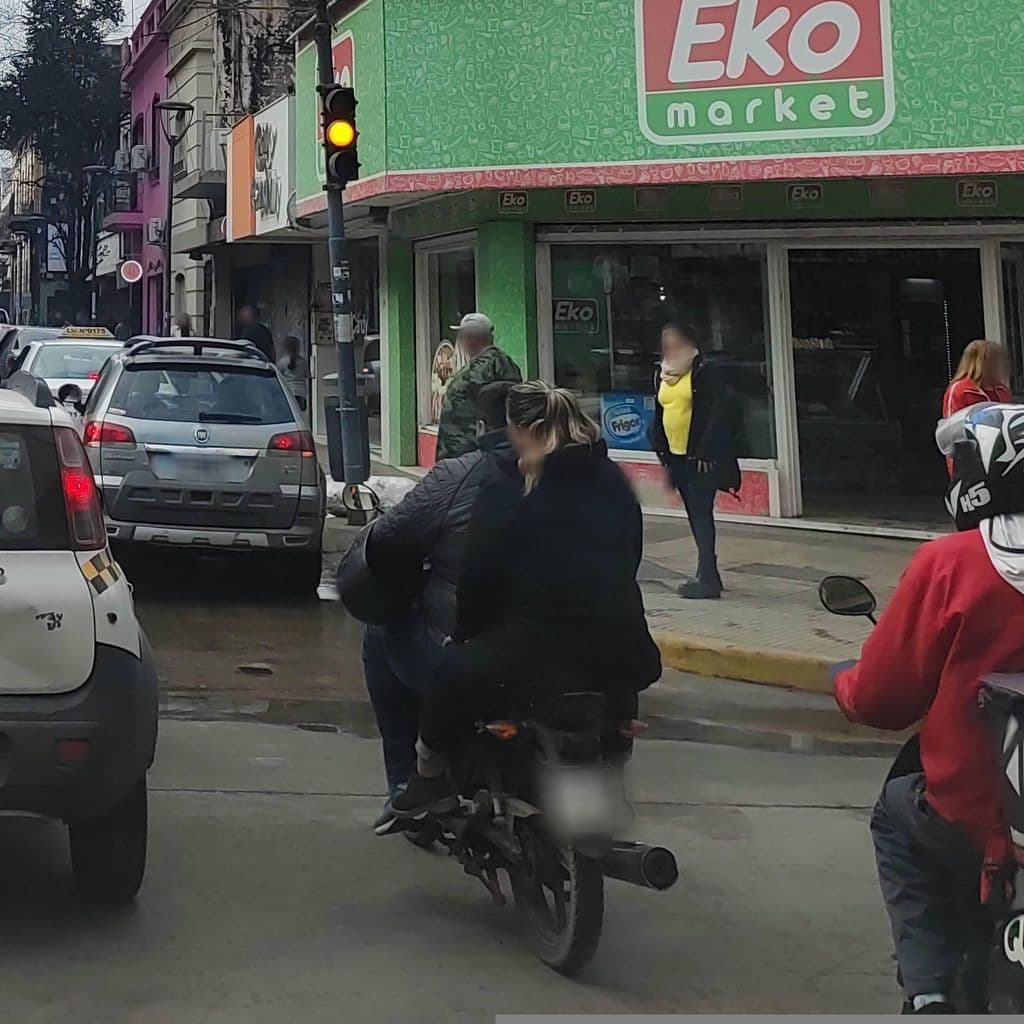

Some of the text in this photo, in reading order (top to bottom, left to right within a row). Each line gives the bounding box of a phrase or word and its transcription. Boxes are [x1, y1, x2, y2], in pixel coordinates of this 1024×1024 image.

[666, 84, 873, 129] market
[569, 191, 593, 205] Eko
[791, 186, 819, 200] Eko
[962, 183, 993, 198] Eko
[502, 192, 525, 206] Eko
[555, 301, 594, 321] Eko
[611, 417, 640, 433] Frigor
